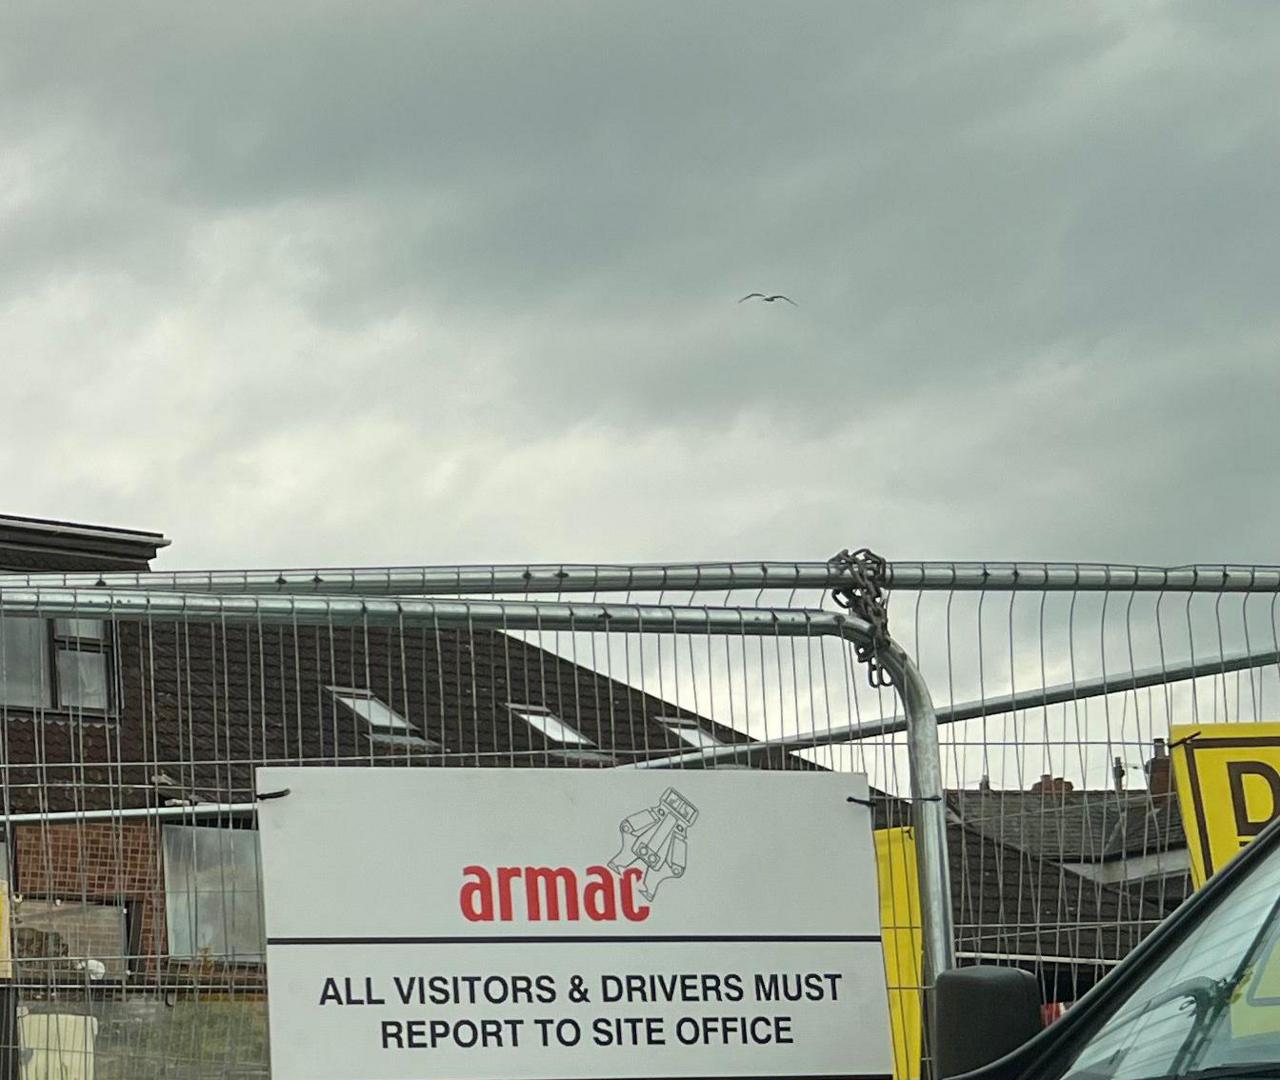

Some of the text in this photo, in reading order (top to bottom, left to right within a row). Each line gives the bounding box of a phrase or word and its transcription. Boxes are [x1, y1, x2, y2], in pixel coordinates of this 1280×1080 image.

[458, 864, 651, 923] armac
[318, 972, 843, 1007] ALL VISITORS & DRIVERS MUST
[380, 1015, 795, 1049] REPORT TO SITE OFFICE
